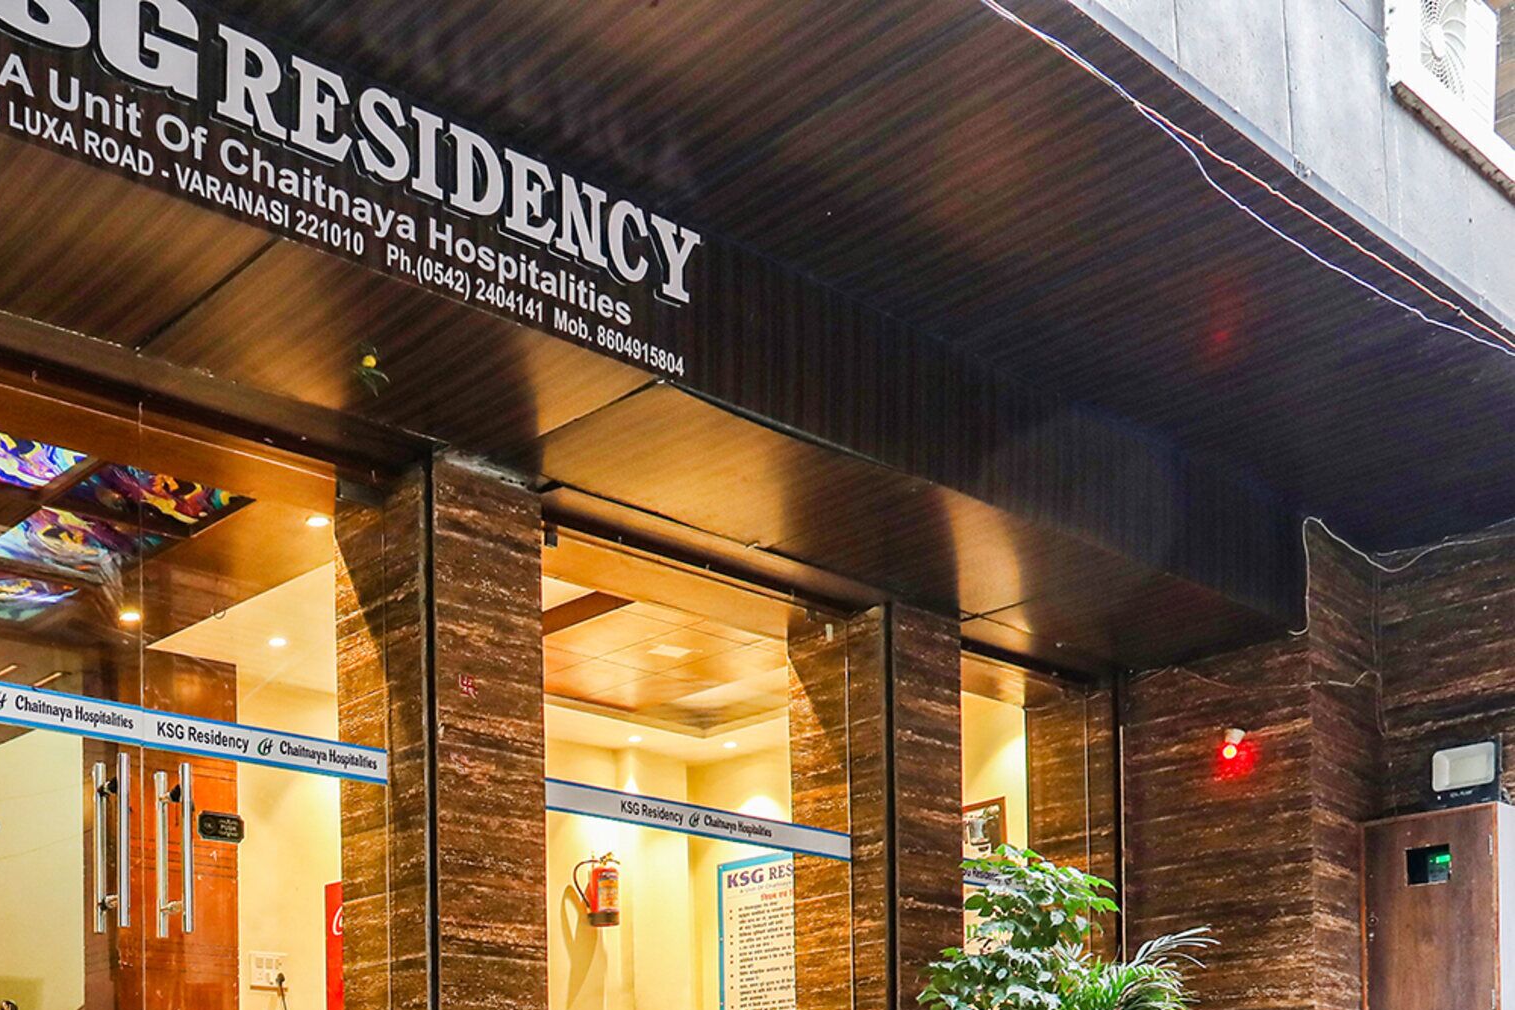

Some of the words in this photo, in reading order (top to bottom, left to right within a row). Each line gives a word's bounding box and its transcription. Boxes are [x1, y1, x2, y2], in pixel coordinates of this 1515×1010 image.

[217, 23, 701, 303] RESIDENCY
[49, 68, 143, 138] Unit
[155, 113, 208, 160] Of
[219, 140, 416, 242] Chaitnaya
[430, 218, 632, 325] Hospitalities
[9, 101, 78, 151] LUXA
[84, 130, 154, 177] ROAD
[174, 162, 290, 229] VARANASI
[295, 210, 364, 255] 221010
[386, 244, 471, 301] Ph.(0542)
[475, 277, 544, 323] 2404141
[554, 307, 592, 341] Mob.
[597, 325, 685, 376] 8604915804
[15, 694, 73, 722] Chaitnaya
[75, 705, 134, 730] Hospitalities
[156, 721, 184, 740] KSG
[188, 726, 249, 754] Residency
[279, 740, 327, 765] Chaitnaya
[329, 750, 377, 770] Hospitalities
[620, 800, 640, 816] KSG
[641, 803, 683, 826] Residency
[727, 867, 764, 888] KSG
